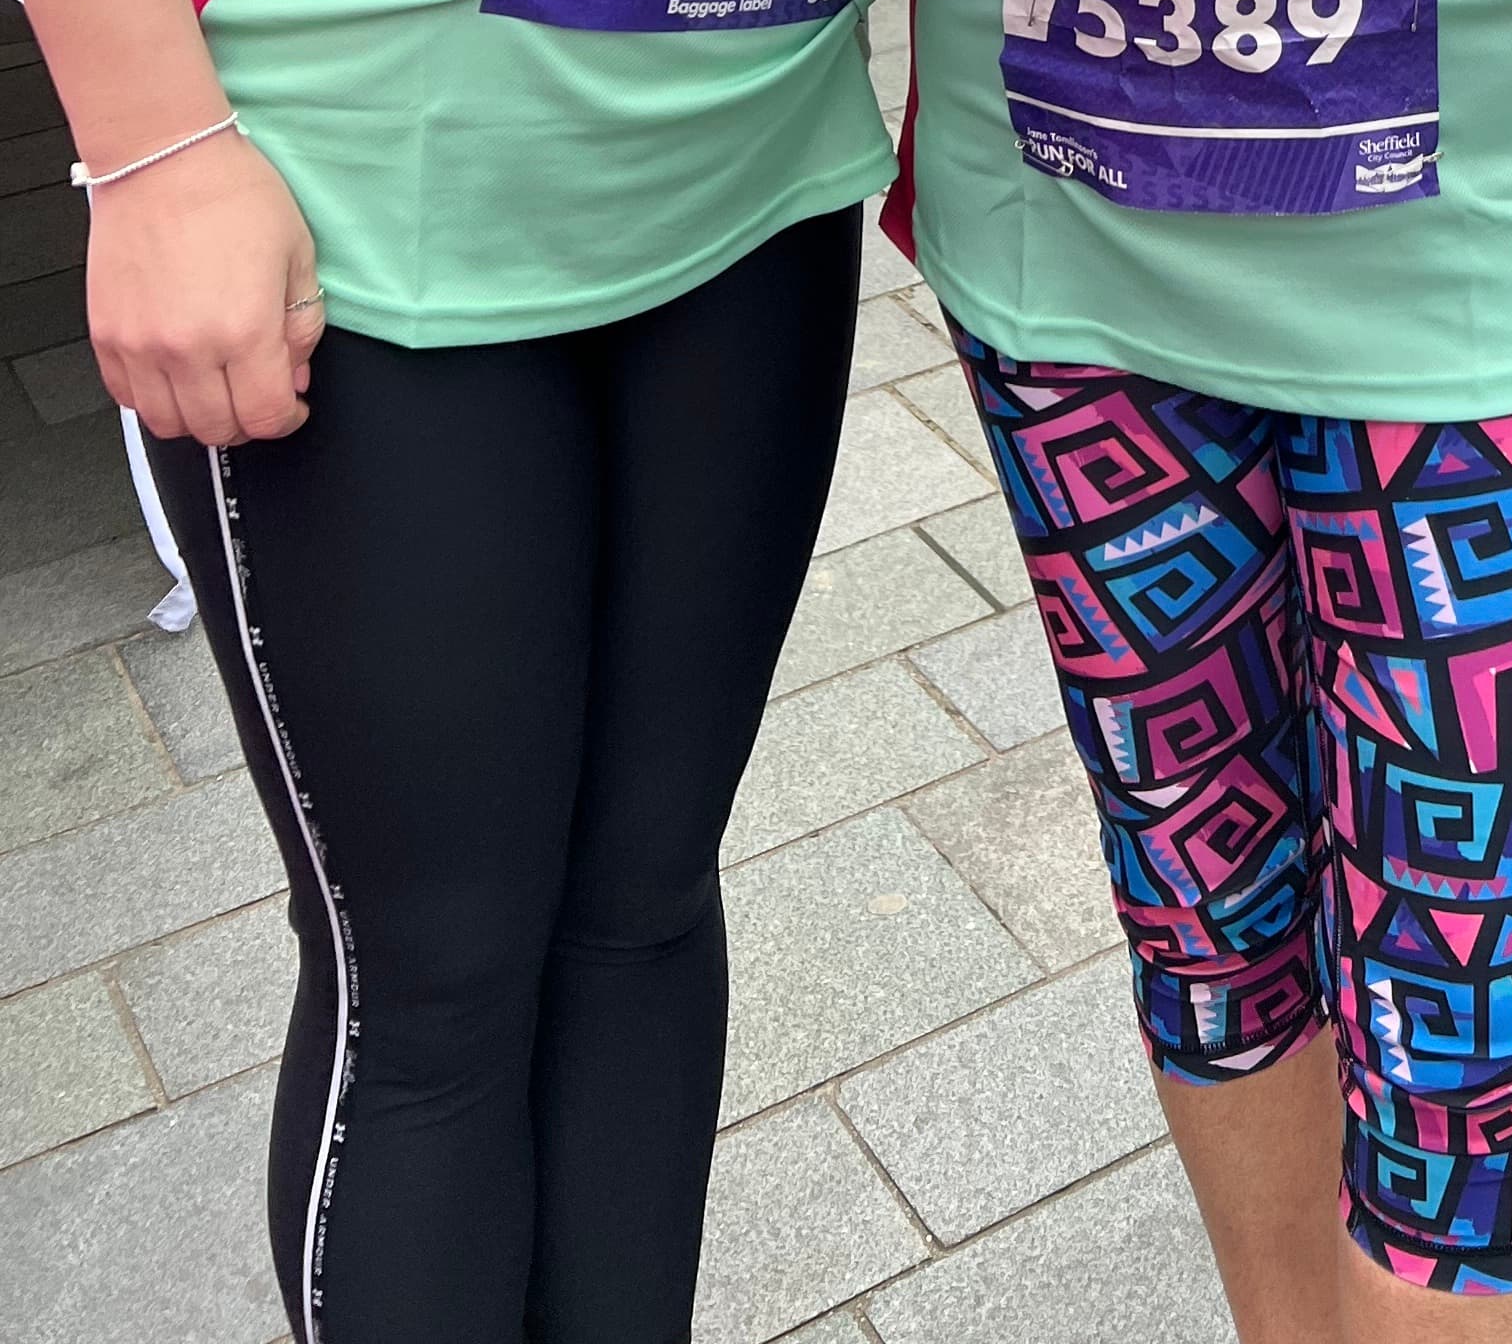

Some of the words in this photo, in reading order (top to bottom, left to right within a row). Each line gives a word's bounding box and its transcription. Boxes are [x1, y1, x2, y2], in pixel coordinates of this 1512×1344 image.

[1359, 131, 1420, 156] Sheffield
[1384, 149, 1413, 159] Council
[1067, 148, 1096, 177] FOR
[1098, 165, 1128, 190] ALL
